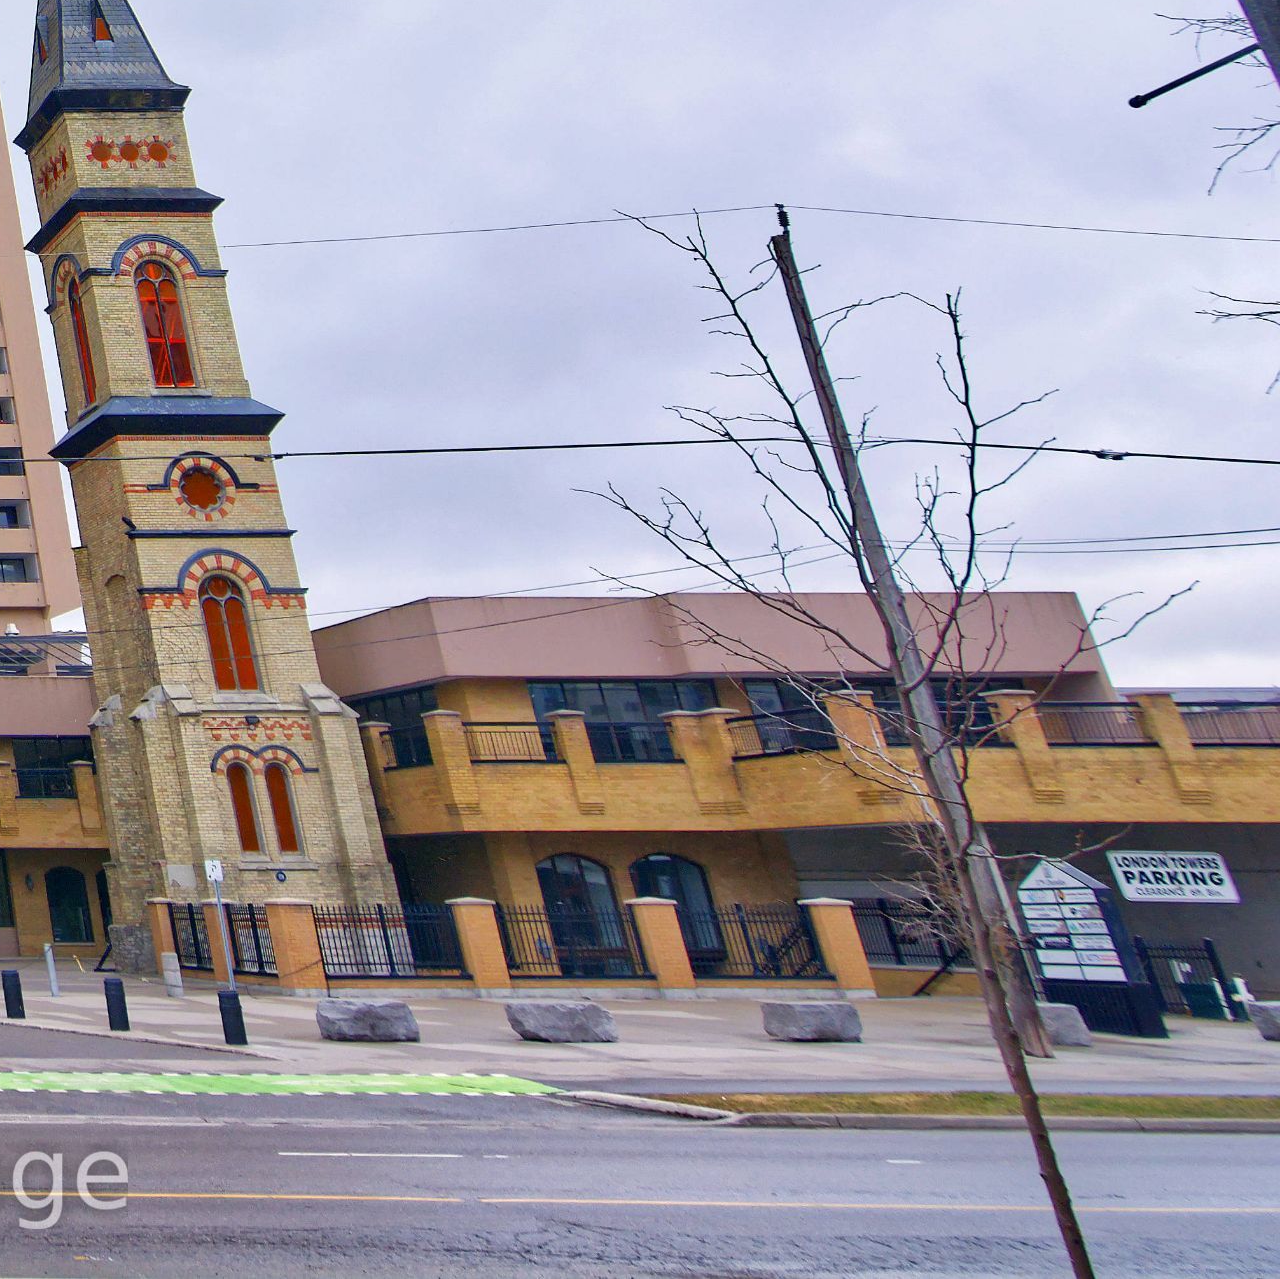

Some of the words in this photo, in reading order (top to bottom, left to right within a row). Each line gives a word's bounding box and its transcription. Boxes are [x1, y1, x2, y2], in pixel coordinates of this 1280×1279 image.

[1113, 856, 1169, 869] LONDON
[1169, 857, 1220, 869] TOWERS
[1122, 870, 1225, 886] PARKING
